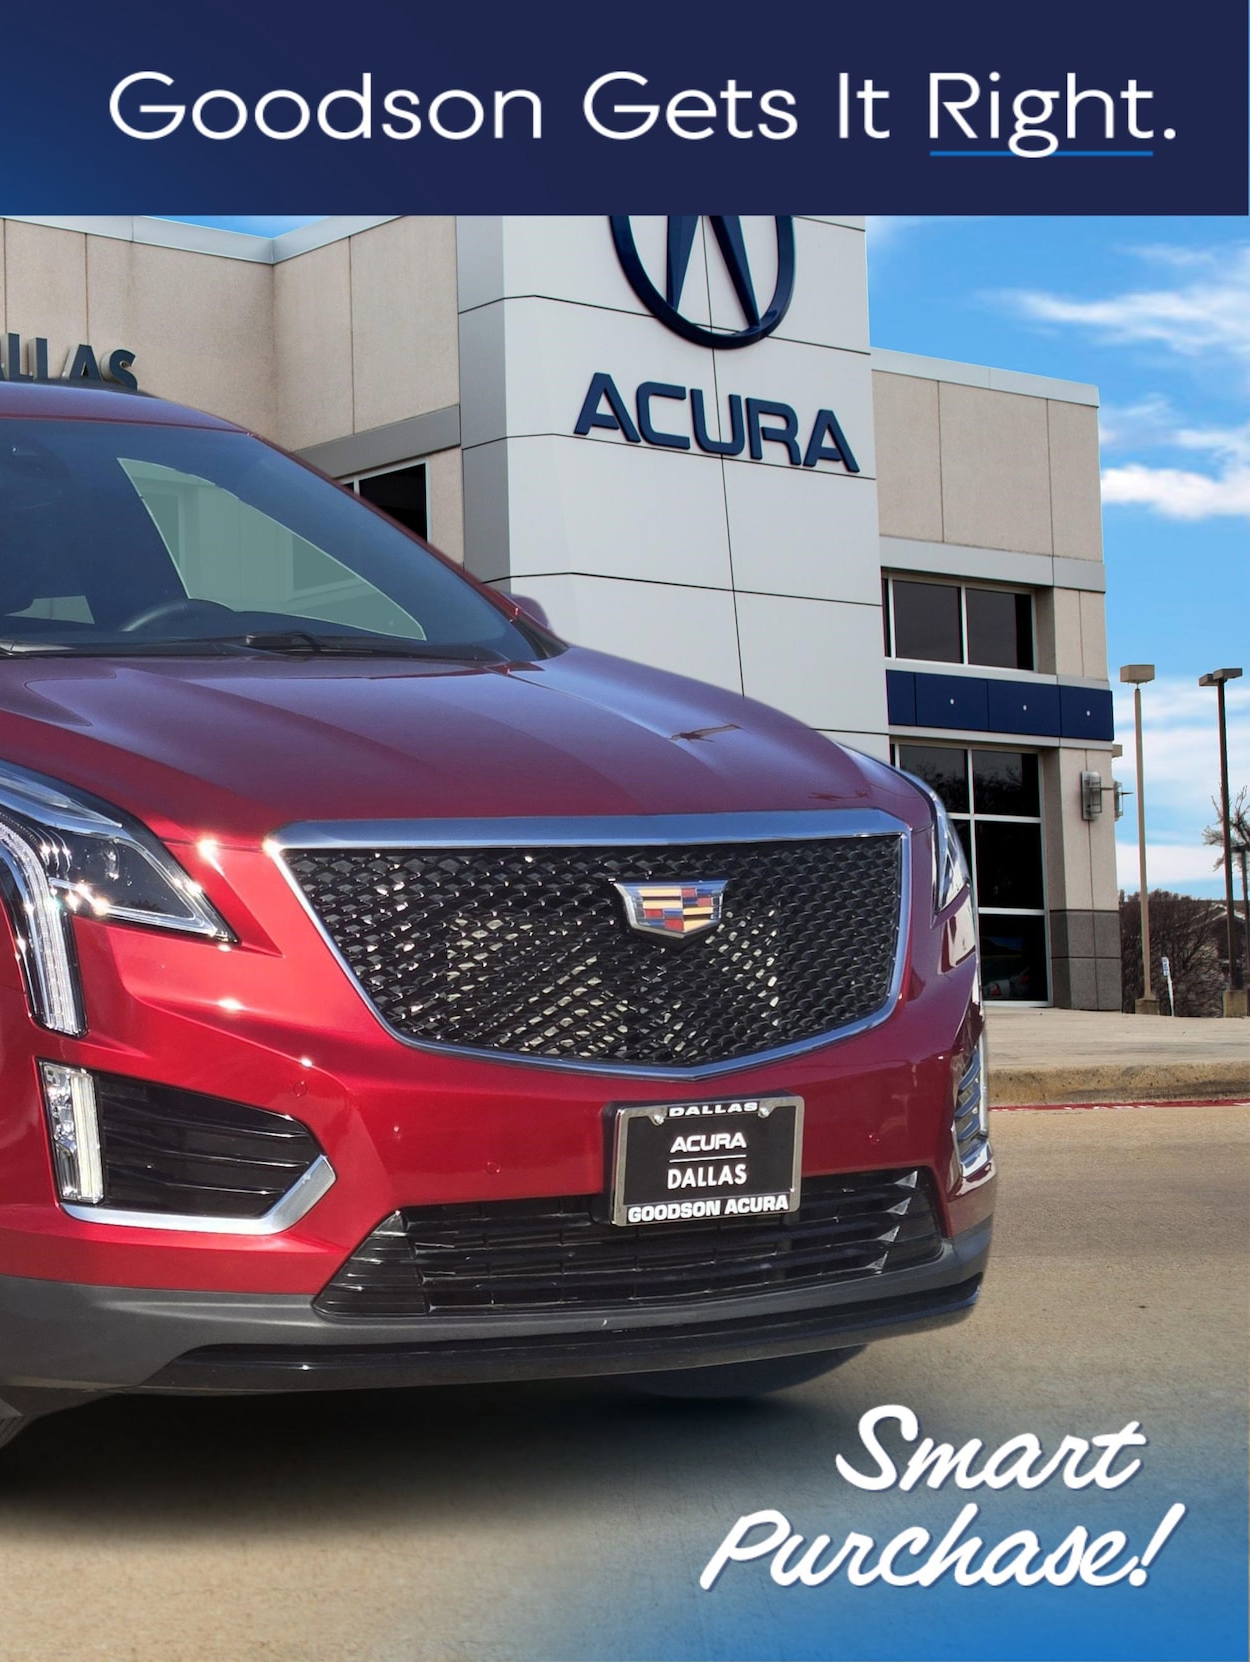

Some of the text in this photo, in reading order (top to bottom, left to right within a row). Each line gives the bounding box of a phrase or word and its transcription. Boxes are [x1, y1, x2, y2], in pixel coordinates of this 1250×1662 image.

[574, 372, 861, 473] ACURA
[668, 1102, 759, 1117] DALLAS
[669, 1132, 747, 1153] ACURA
[667, 1163, 747, 1190] DALLAS
[627, 1194, 790, 1224] GOODSON ACURA
